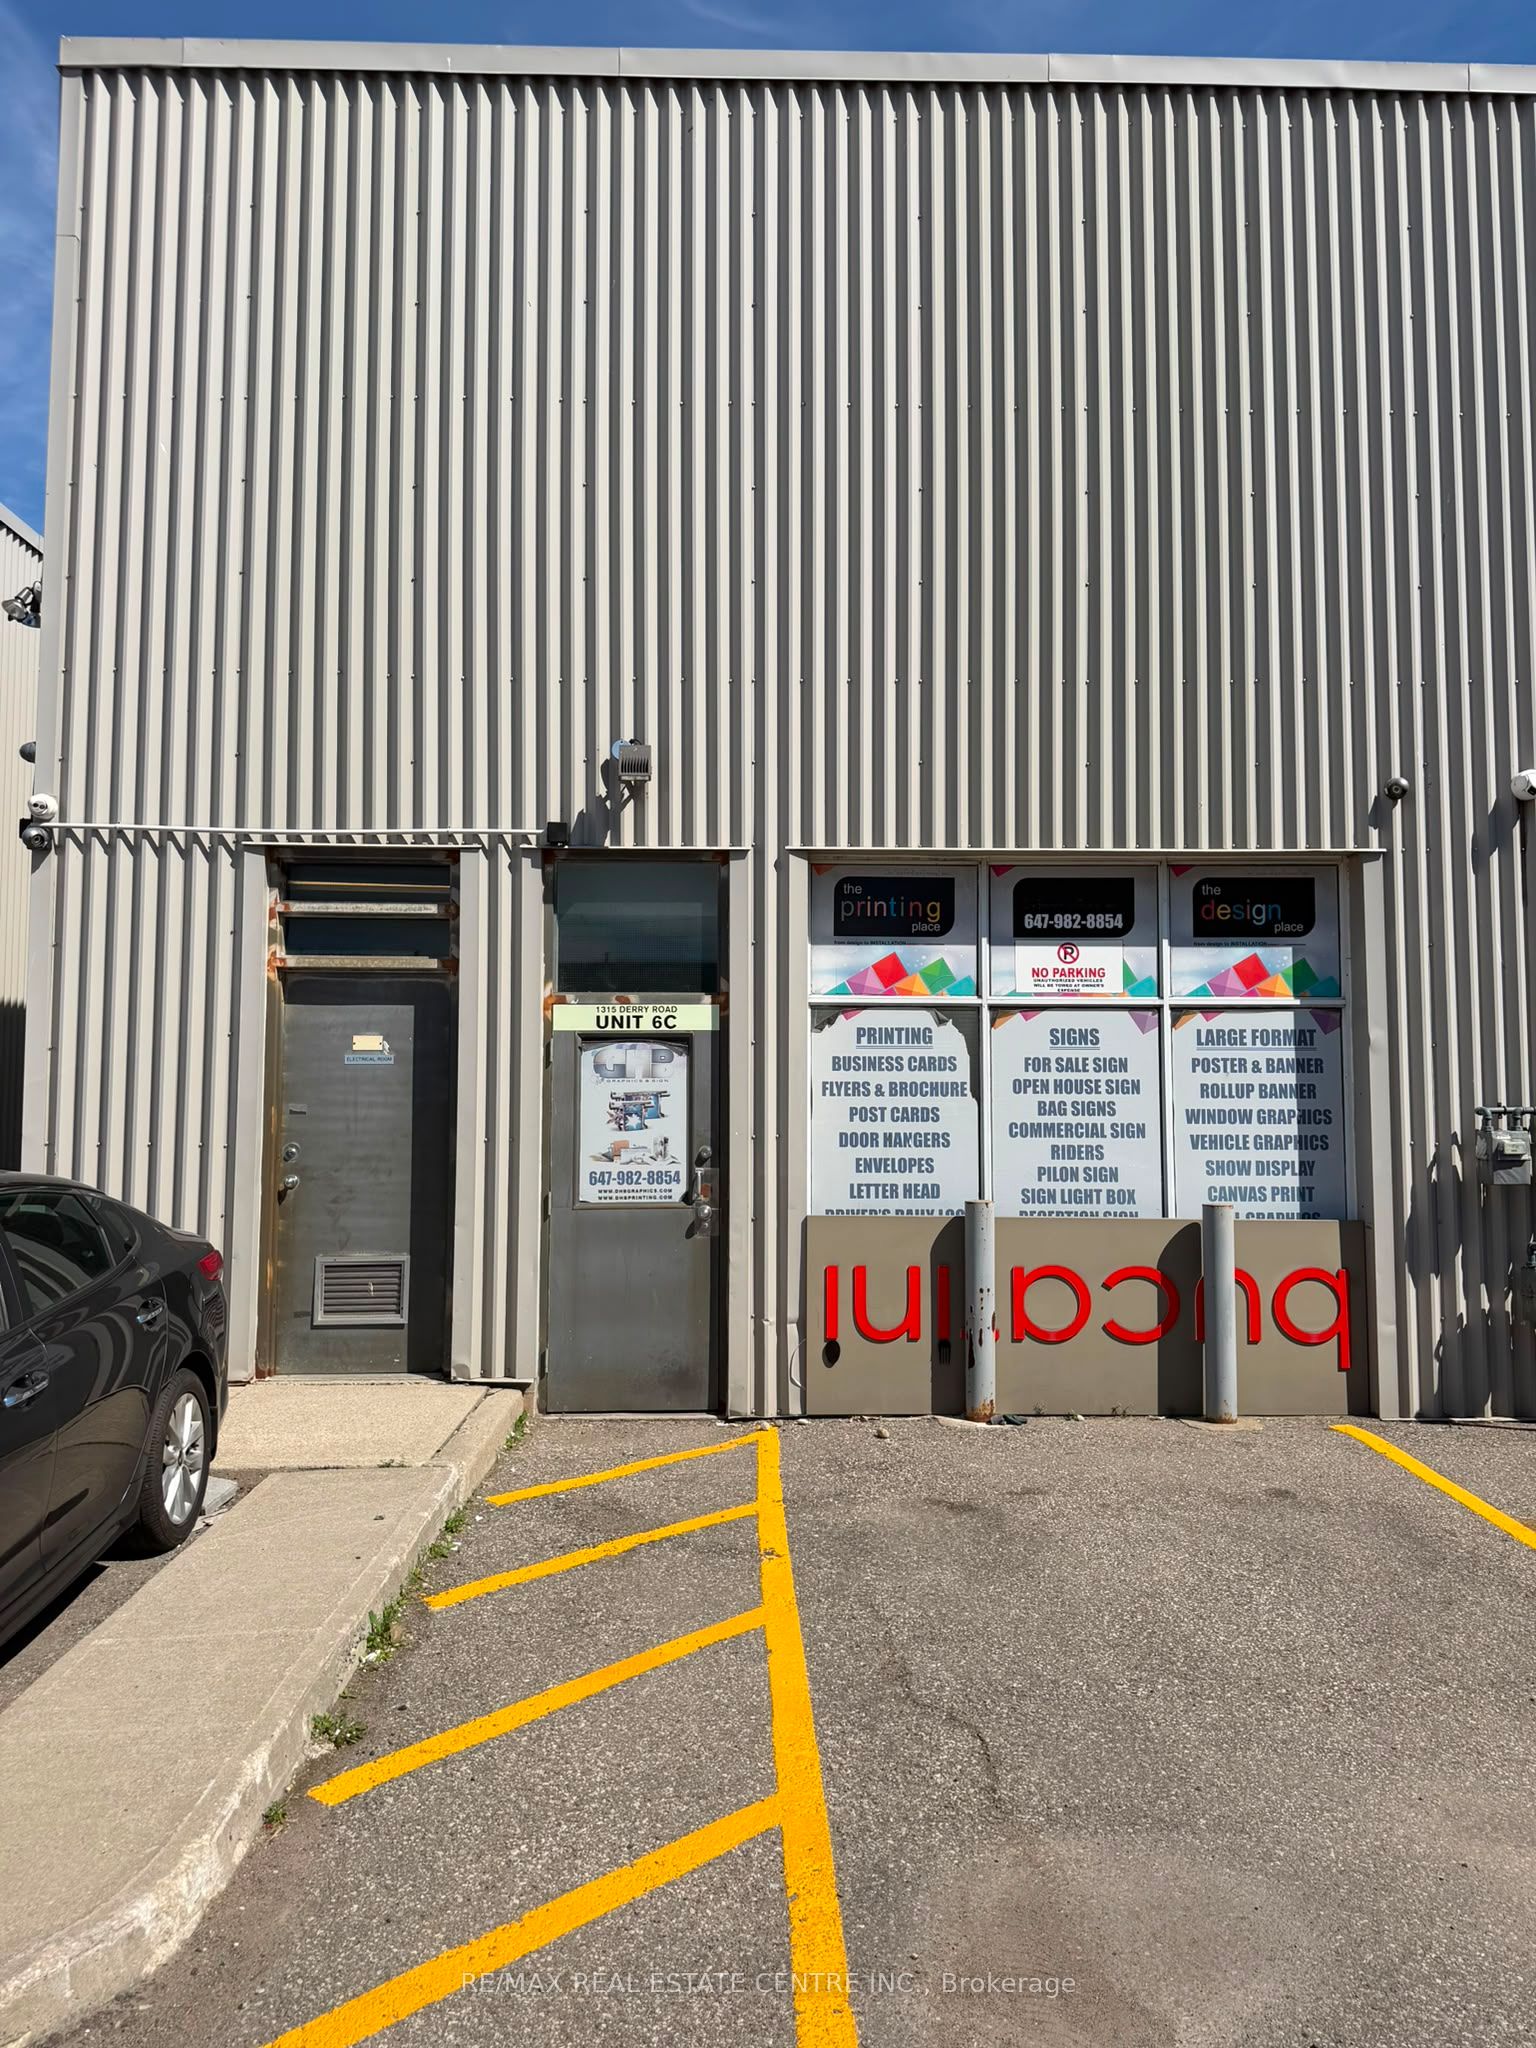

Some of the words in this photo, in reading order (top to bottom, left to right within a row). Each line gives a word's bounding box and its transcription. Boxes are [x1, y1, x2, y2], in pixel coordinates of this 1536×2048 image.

[843, 883, 862, 895] the
[1202, 884, 1221, 895] the
[840, 896, 941, 923] printing
[1201, 899, 1281, 924] design
[911, 921, 941, 934] place
[1024, 913, 1123, 929] 647-982-8854
[1274, 921, 1303, 934] place
[1031, 967, 1049, 978] NO
[1053, 967, 1106, 978] PARKING
[596, 1015, 643, 1029] UNIT
[652, 1015, 677, 1029] 6C
[856, 1027, 933, 1044] PRINTING
[1050, 1028, 1100, 1046] SIGNS
[1196, 1028, 1247, 1046] LARGE
[1251, 1028, 1316, 1046] FORMAT
[832, 1056, 904, 1072] BUSINESS
[908, 1056, 957, 1072] CARDS
[1024, 1057, 1051, 1073] FOR
[1055, 1057, 1089, 1073] SALE
[1093, 1057, 1128, 1073] SIGN
[1191, 1057, 1247, 1073] POSTER
[1252, 1057, 1262, 1073] &
[1266, 1057, 1324, 1073] BANNER
[822, 1081, 871, 1097] FLYERS
[874, 1081, 885, 1097] &
[889, 1081, 967, 1097] BROCHURE
[1012, 1079, 1049, 1095] OPEN
[1053, 1079, 1101, 1095] HOUSE
[1105, 1079, 1141, 1095] SIGN
[1200, 1083, 1254, 1099] ROLLUP
[1259, 1083, 1316, 1099] BANNER
[849, 1106, 887, 1122] POST
[890, 1106, 940, 1122] CARDS
[1038, 1100, 1067, 1116] BAG
[1071, 1100, 1116, 1116] SIGNS
[1185, 1109, 1253, 1125] WINDOW
[1257, 1109, 1332, 1125] GRAPHICS
[1009, 1122, 1107, 1138] COMMERCIAL
[1110, 1122, 1146, 1138] SIGN
[839, 1132, 879, 1148] DOOR
[883, 1132, 951, 1148] HANGERS
[1190, 1134, 1250, 1150] VEHICLE
[1253, 1134, 1329, 1150] GRAPHICS
[1051, 1144, 1104, 1160] RIDERS
[855, 1157, 934, 1173] ENVELOPES
[1205, 1160, 1252, 1176] SHOW
[1256, 1160, 1315, 1176] DISPLAY
[589, 1170, 681, 1186] 647-982-8854
[1037, 1166, 1079, 1182] PILON
[1083, 1166, 1119, 1182] SIGN
[850, 1183, 899, 1199] LETTER
[903, 1183, 940, 1199] HEAD
[1021, 1188, 1056, 1205] SIGN
[1060, 1188, 1102, 1205] LIGHT
[1106, 1188, 1136, 1205] BOX
[1208, 1186, 1267, 1202] CANVAS
[1271, 1186, 1315, 1202] PRINT
[824, 1265, 1351, 1371] bucaini
